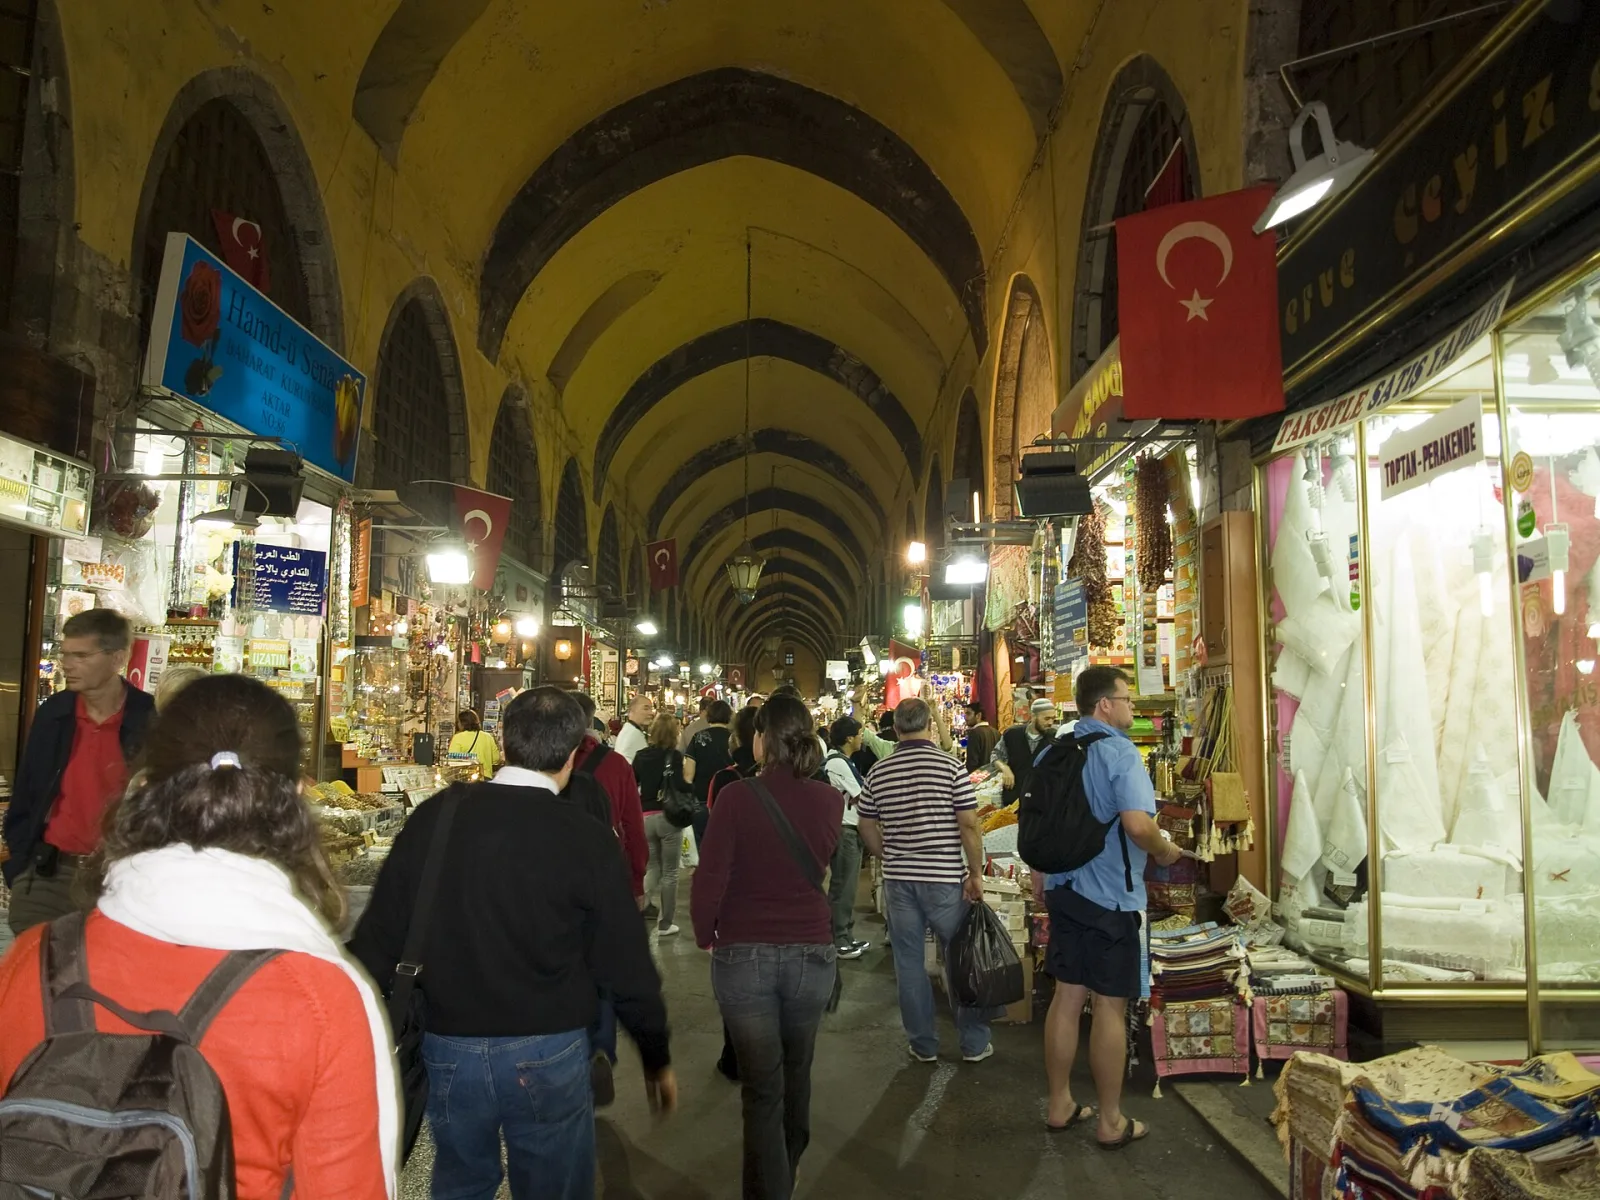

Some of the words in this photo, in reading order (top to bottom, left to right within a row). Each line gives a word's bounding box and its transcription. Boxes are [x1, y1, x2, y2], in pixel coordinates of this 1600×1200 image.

[227, 288, 297, 366] Hamd-ü
[1285, 247, 1356, 336] erve
[1277, 388, 1370, 447] TAKSİTLE
[1366, 355, 1428, 412] SATIŞ
[252, 652, 286, 666] UZATIN
